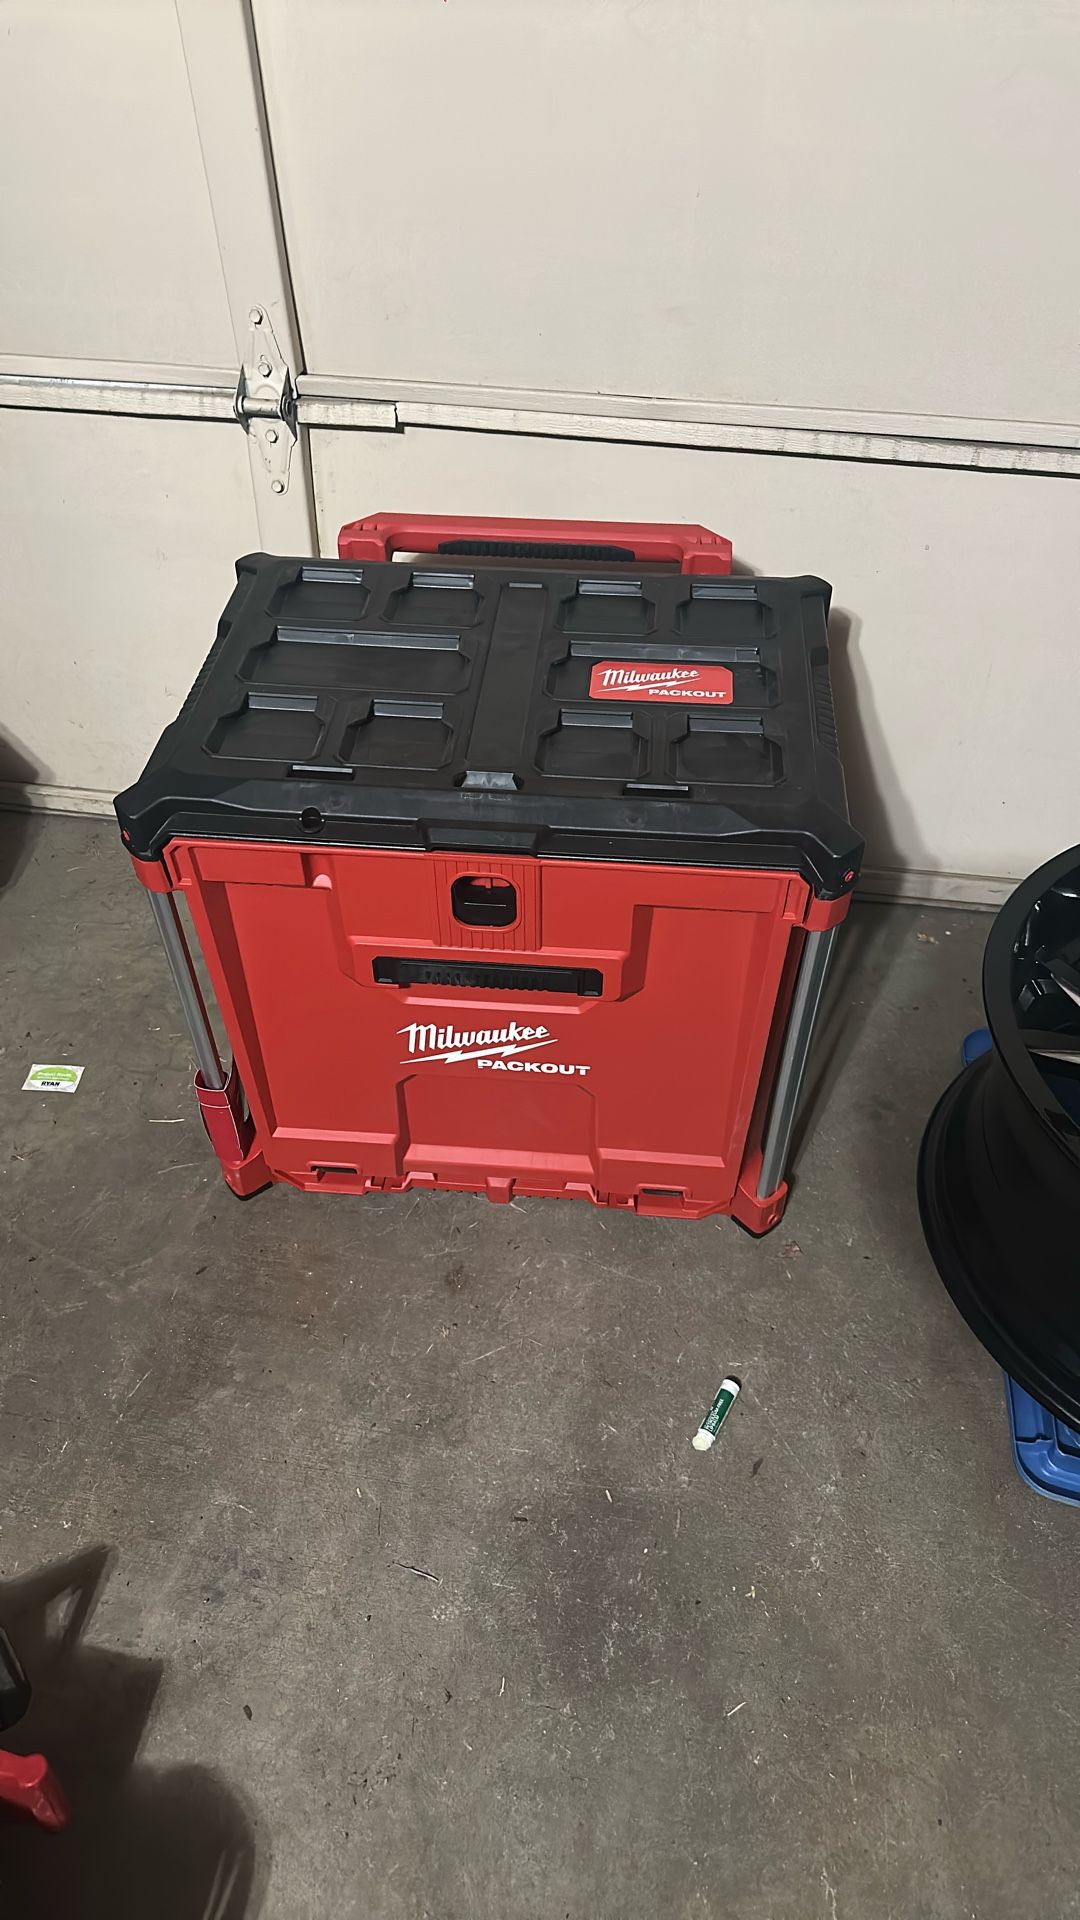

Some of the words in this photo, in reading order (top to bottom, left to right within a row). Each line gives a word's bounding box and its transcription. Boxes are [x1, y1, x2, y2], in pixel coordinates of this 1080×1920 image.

[597, 668, 700, 686] Milwaukee
[648, 689, 727, 698] PACKOUT
[396, 1022, 550, 1053] Milwaukee
[477, 1059, 591, 1076] PACKOUT
